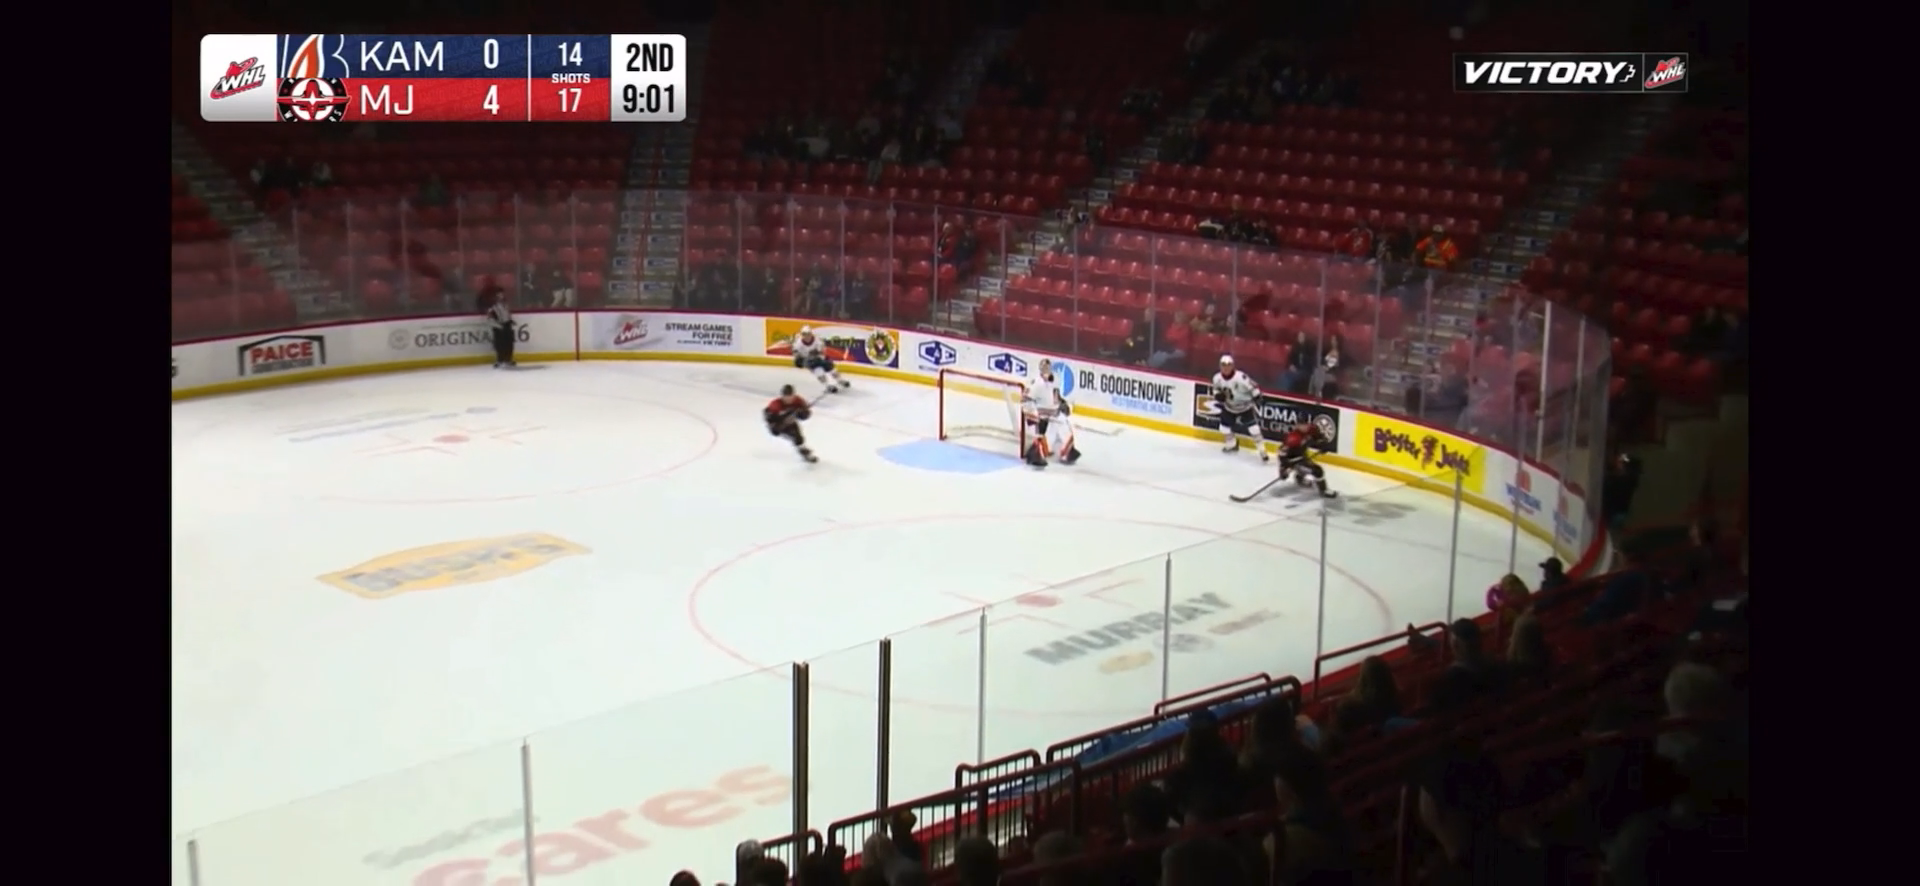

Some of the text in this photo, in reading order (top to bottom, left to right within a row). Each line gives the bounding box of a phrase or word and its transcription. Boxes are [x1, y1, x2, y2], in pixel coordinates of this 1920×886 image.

[414, 323, 531, 348] ORIGINA 6
[665, 323, 733, 333] STREAM GAMES
[711, 332, 733, 341] FREE
[250, 342, 313, 364] PAICE
[1079, 369, 1173, 405] DR. GOODENOWE
[1023, 592, 1232, 666] MURRAY
